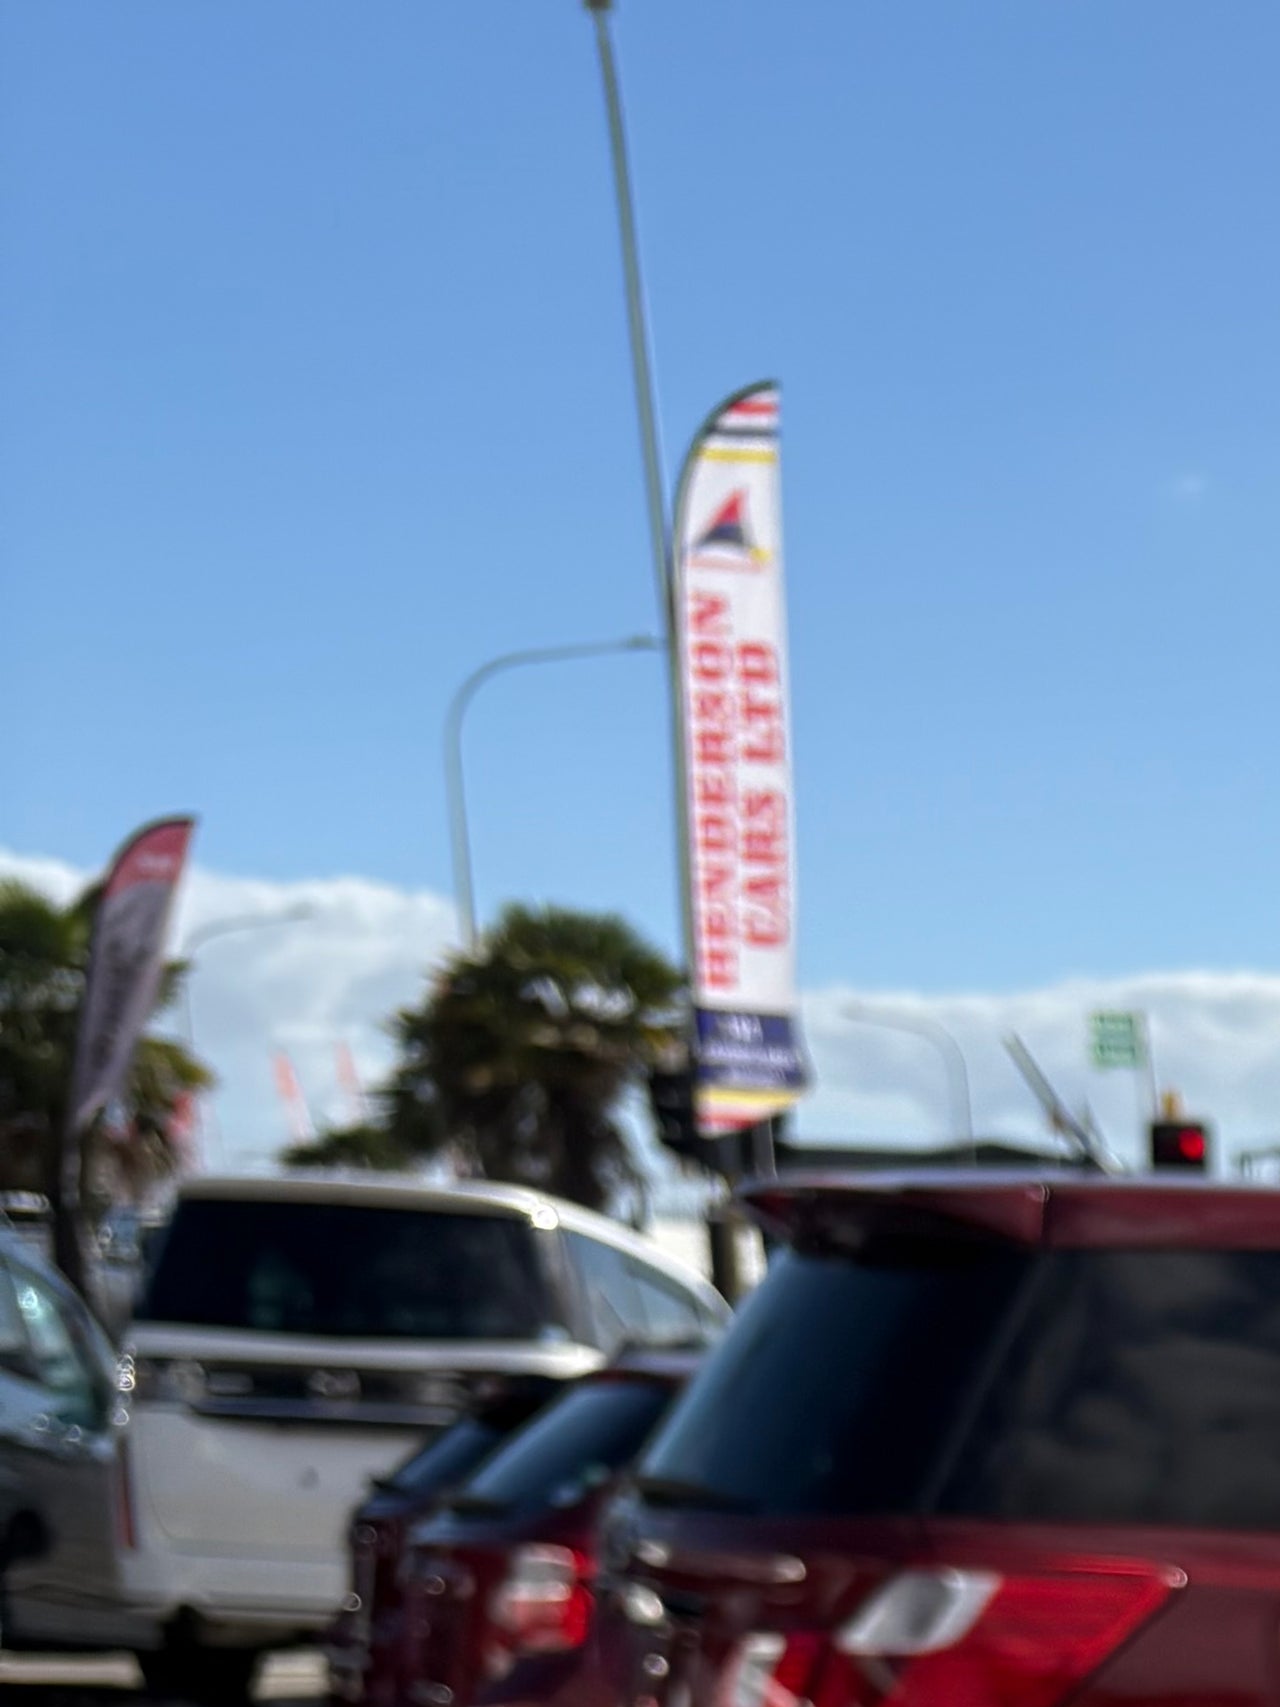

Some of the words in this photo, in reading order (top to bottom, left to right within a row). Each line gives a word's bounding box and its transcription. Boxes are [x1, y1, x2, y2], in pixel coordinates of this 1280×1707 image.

[735, 640, 786, 766] LTD
[690, 588, 738, 992] HENDERSON
[740, 788, 790, 952] CARS
